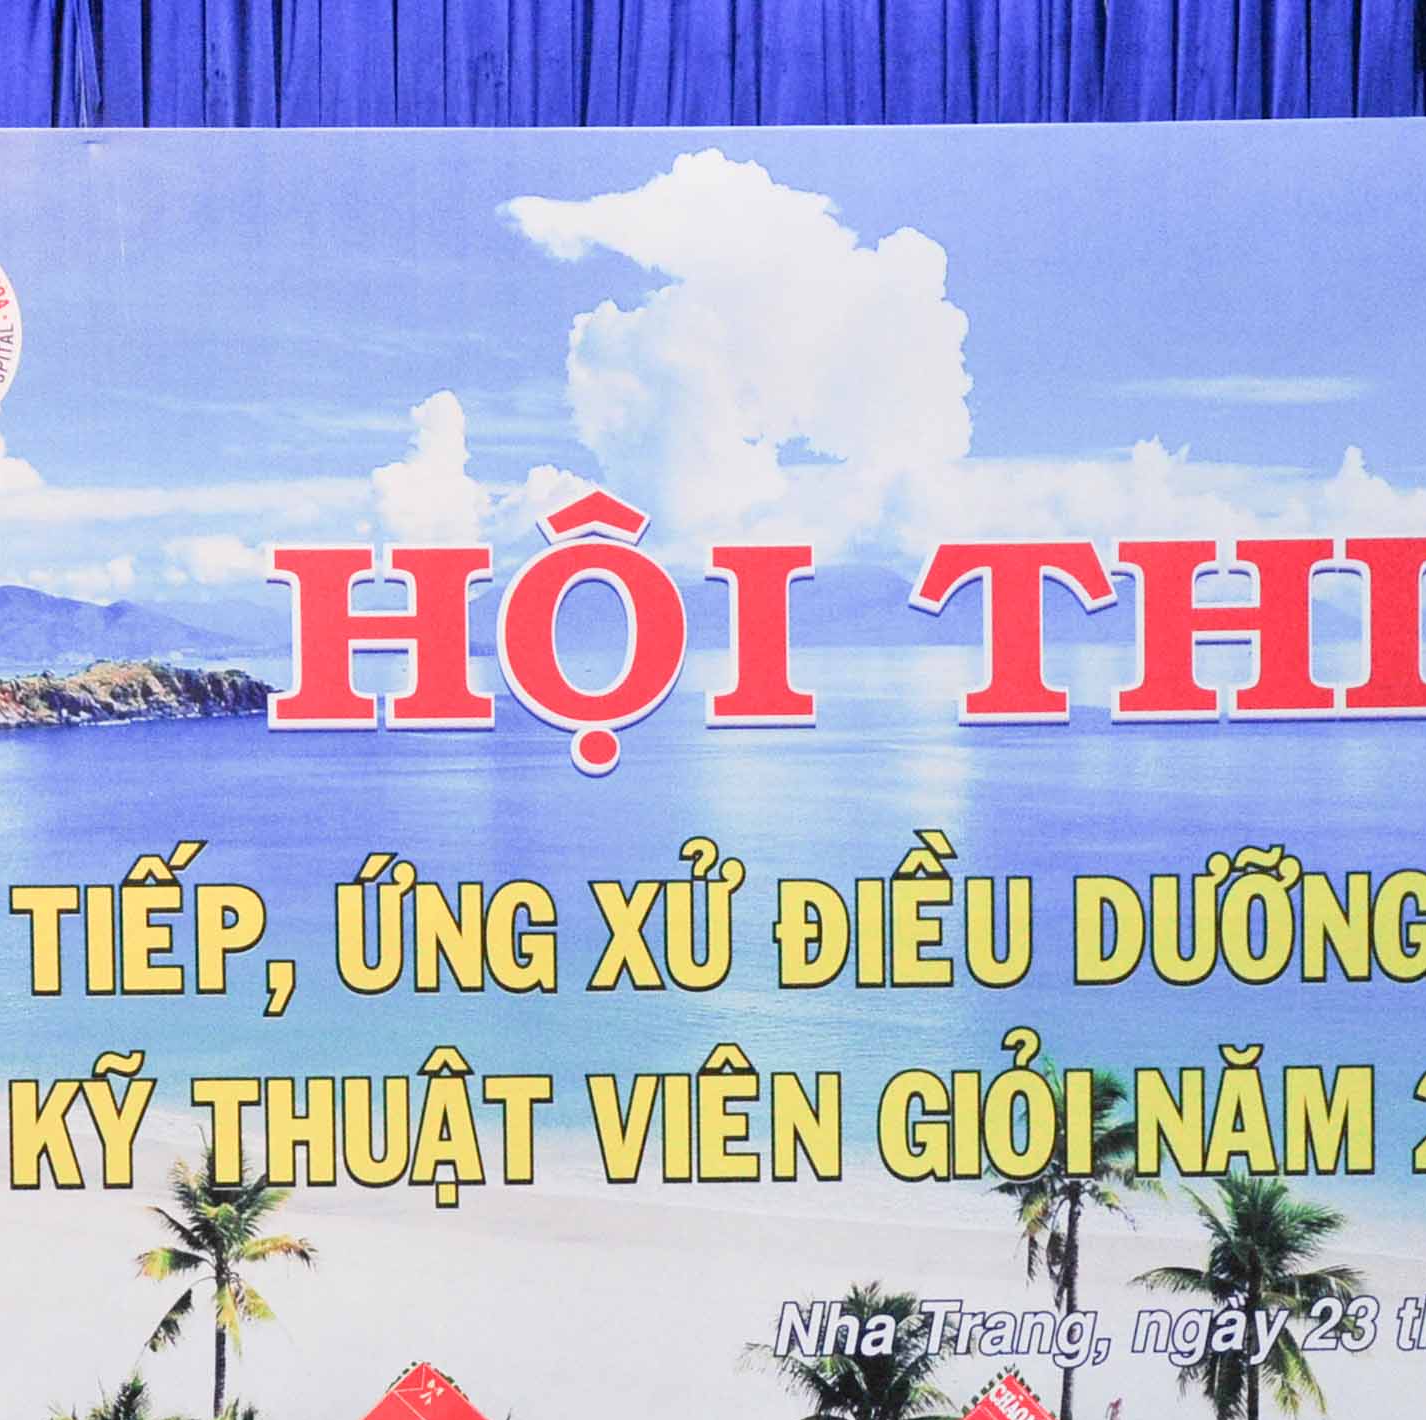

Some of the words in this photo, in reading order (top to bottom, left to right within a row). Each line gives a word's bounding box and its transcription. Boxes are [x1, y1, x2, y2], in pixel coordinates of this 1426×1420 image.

[267, 487, 816, 776] HỘI
[8, 840, 297, 1017] TIẾP,
[334, 851, 559, 994] ỨNG
[587, 837, 744, 991] XỬ
[771, 829, 1031, 988] ĐIỀU
[8, 1049, 156, 1189] KỸ
[191, 1046, 554, 1208] THUẬT
[586, 1042, 843, 1186] VIÊN
[878, 1027, 1094, 1182] GIỎI
[1134, 1043, 1375, 1177] NĂM
[775, 1302, 894, 1358] Nha
[917, 1298, 1112, 1367] Trang,
[1132, 1297, 1284, 1365] ngày
[1302, 1297, 1376, 1351] 23
